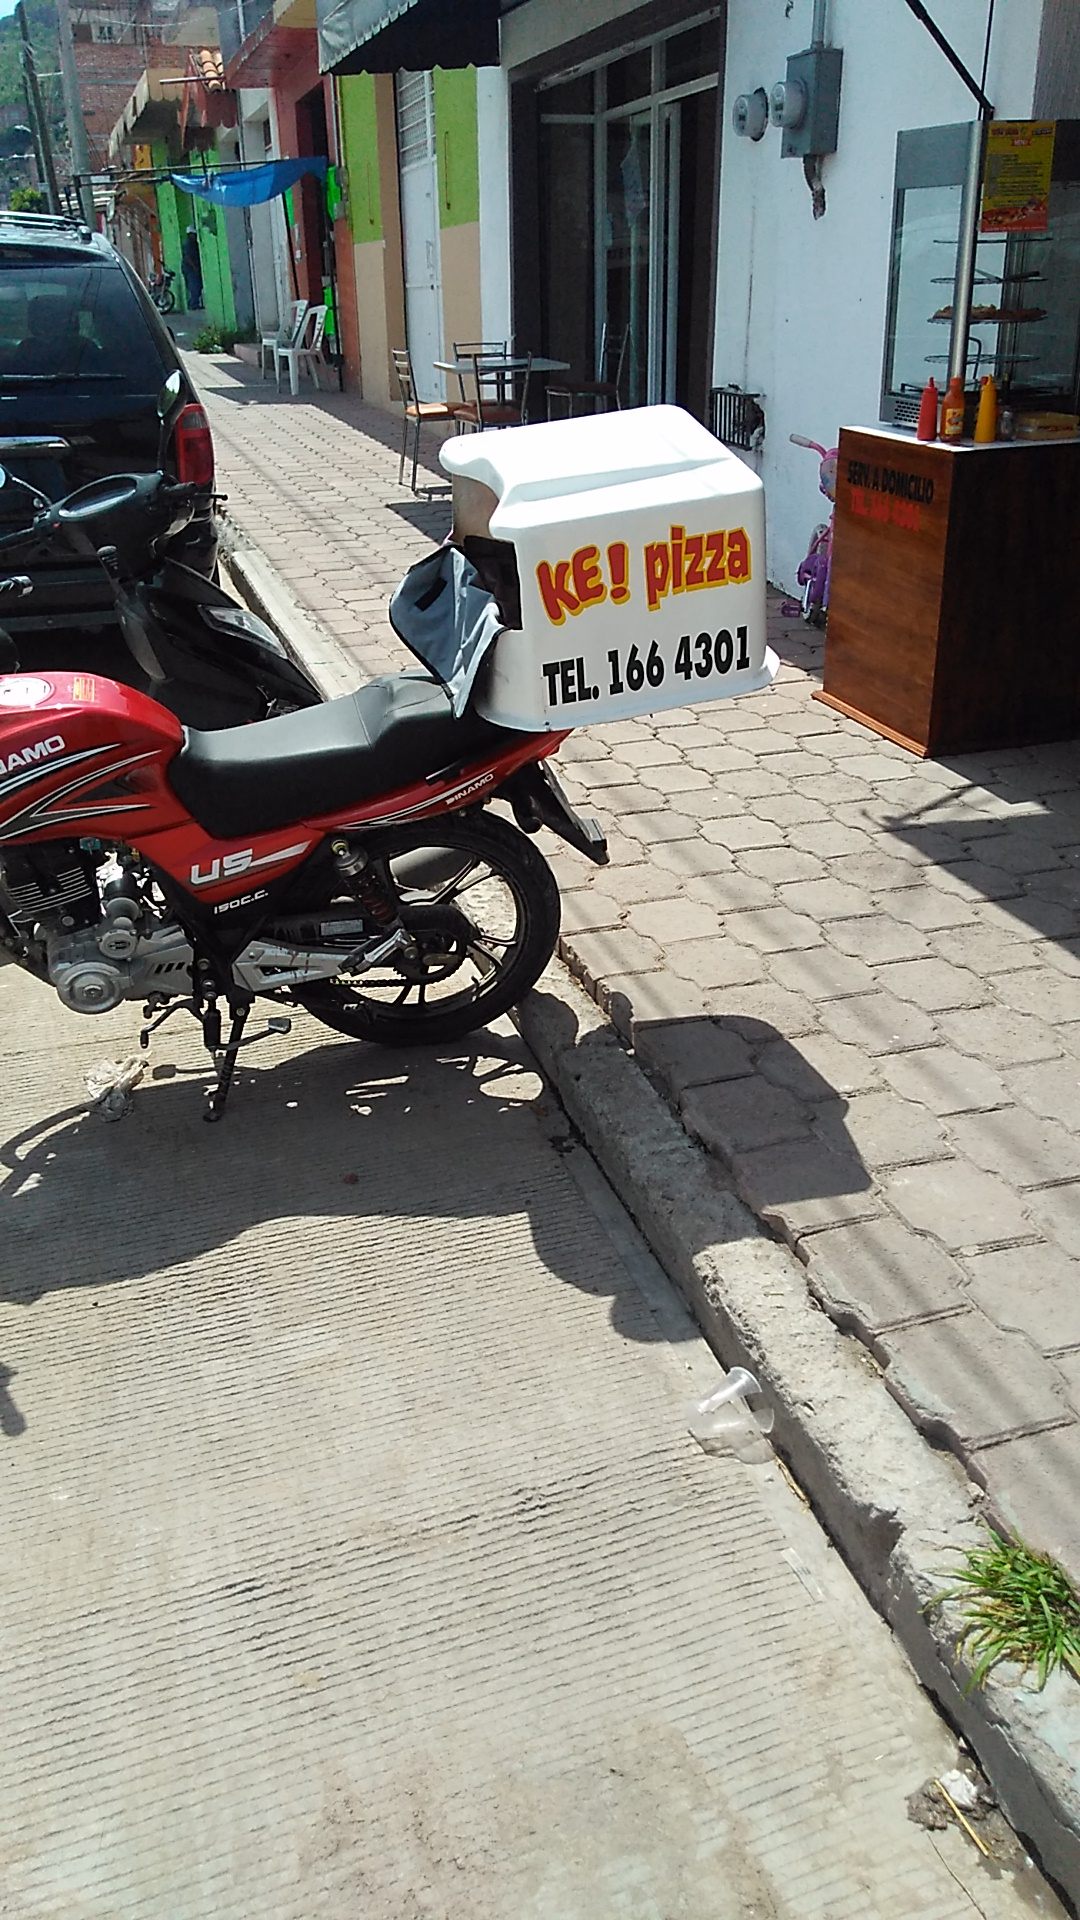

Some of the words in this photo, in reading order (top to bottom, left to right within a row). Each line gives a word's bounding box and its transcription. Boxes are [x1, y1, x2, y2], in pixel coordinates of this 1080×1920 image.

[880, 467, 934, 505] DOMICILIO
[536, 541, 630, 625] KE!
[644, 524, 751, 611] pizza
[542, 657, 599, 706] TEL.
[608, 640, 664, 695] 166
[675, 626, 750, 680] 4301
[445, 773, 494, 805] DINAMO
[190, 849, 253, 884] US
